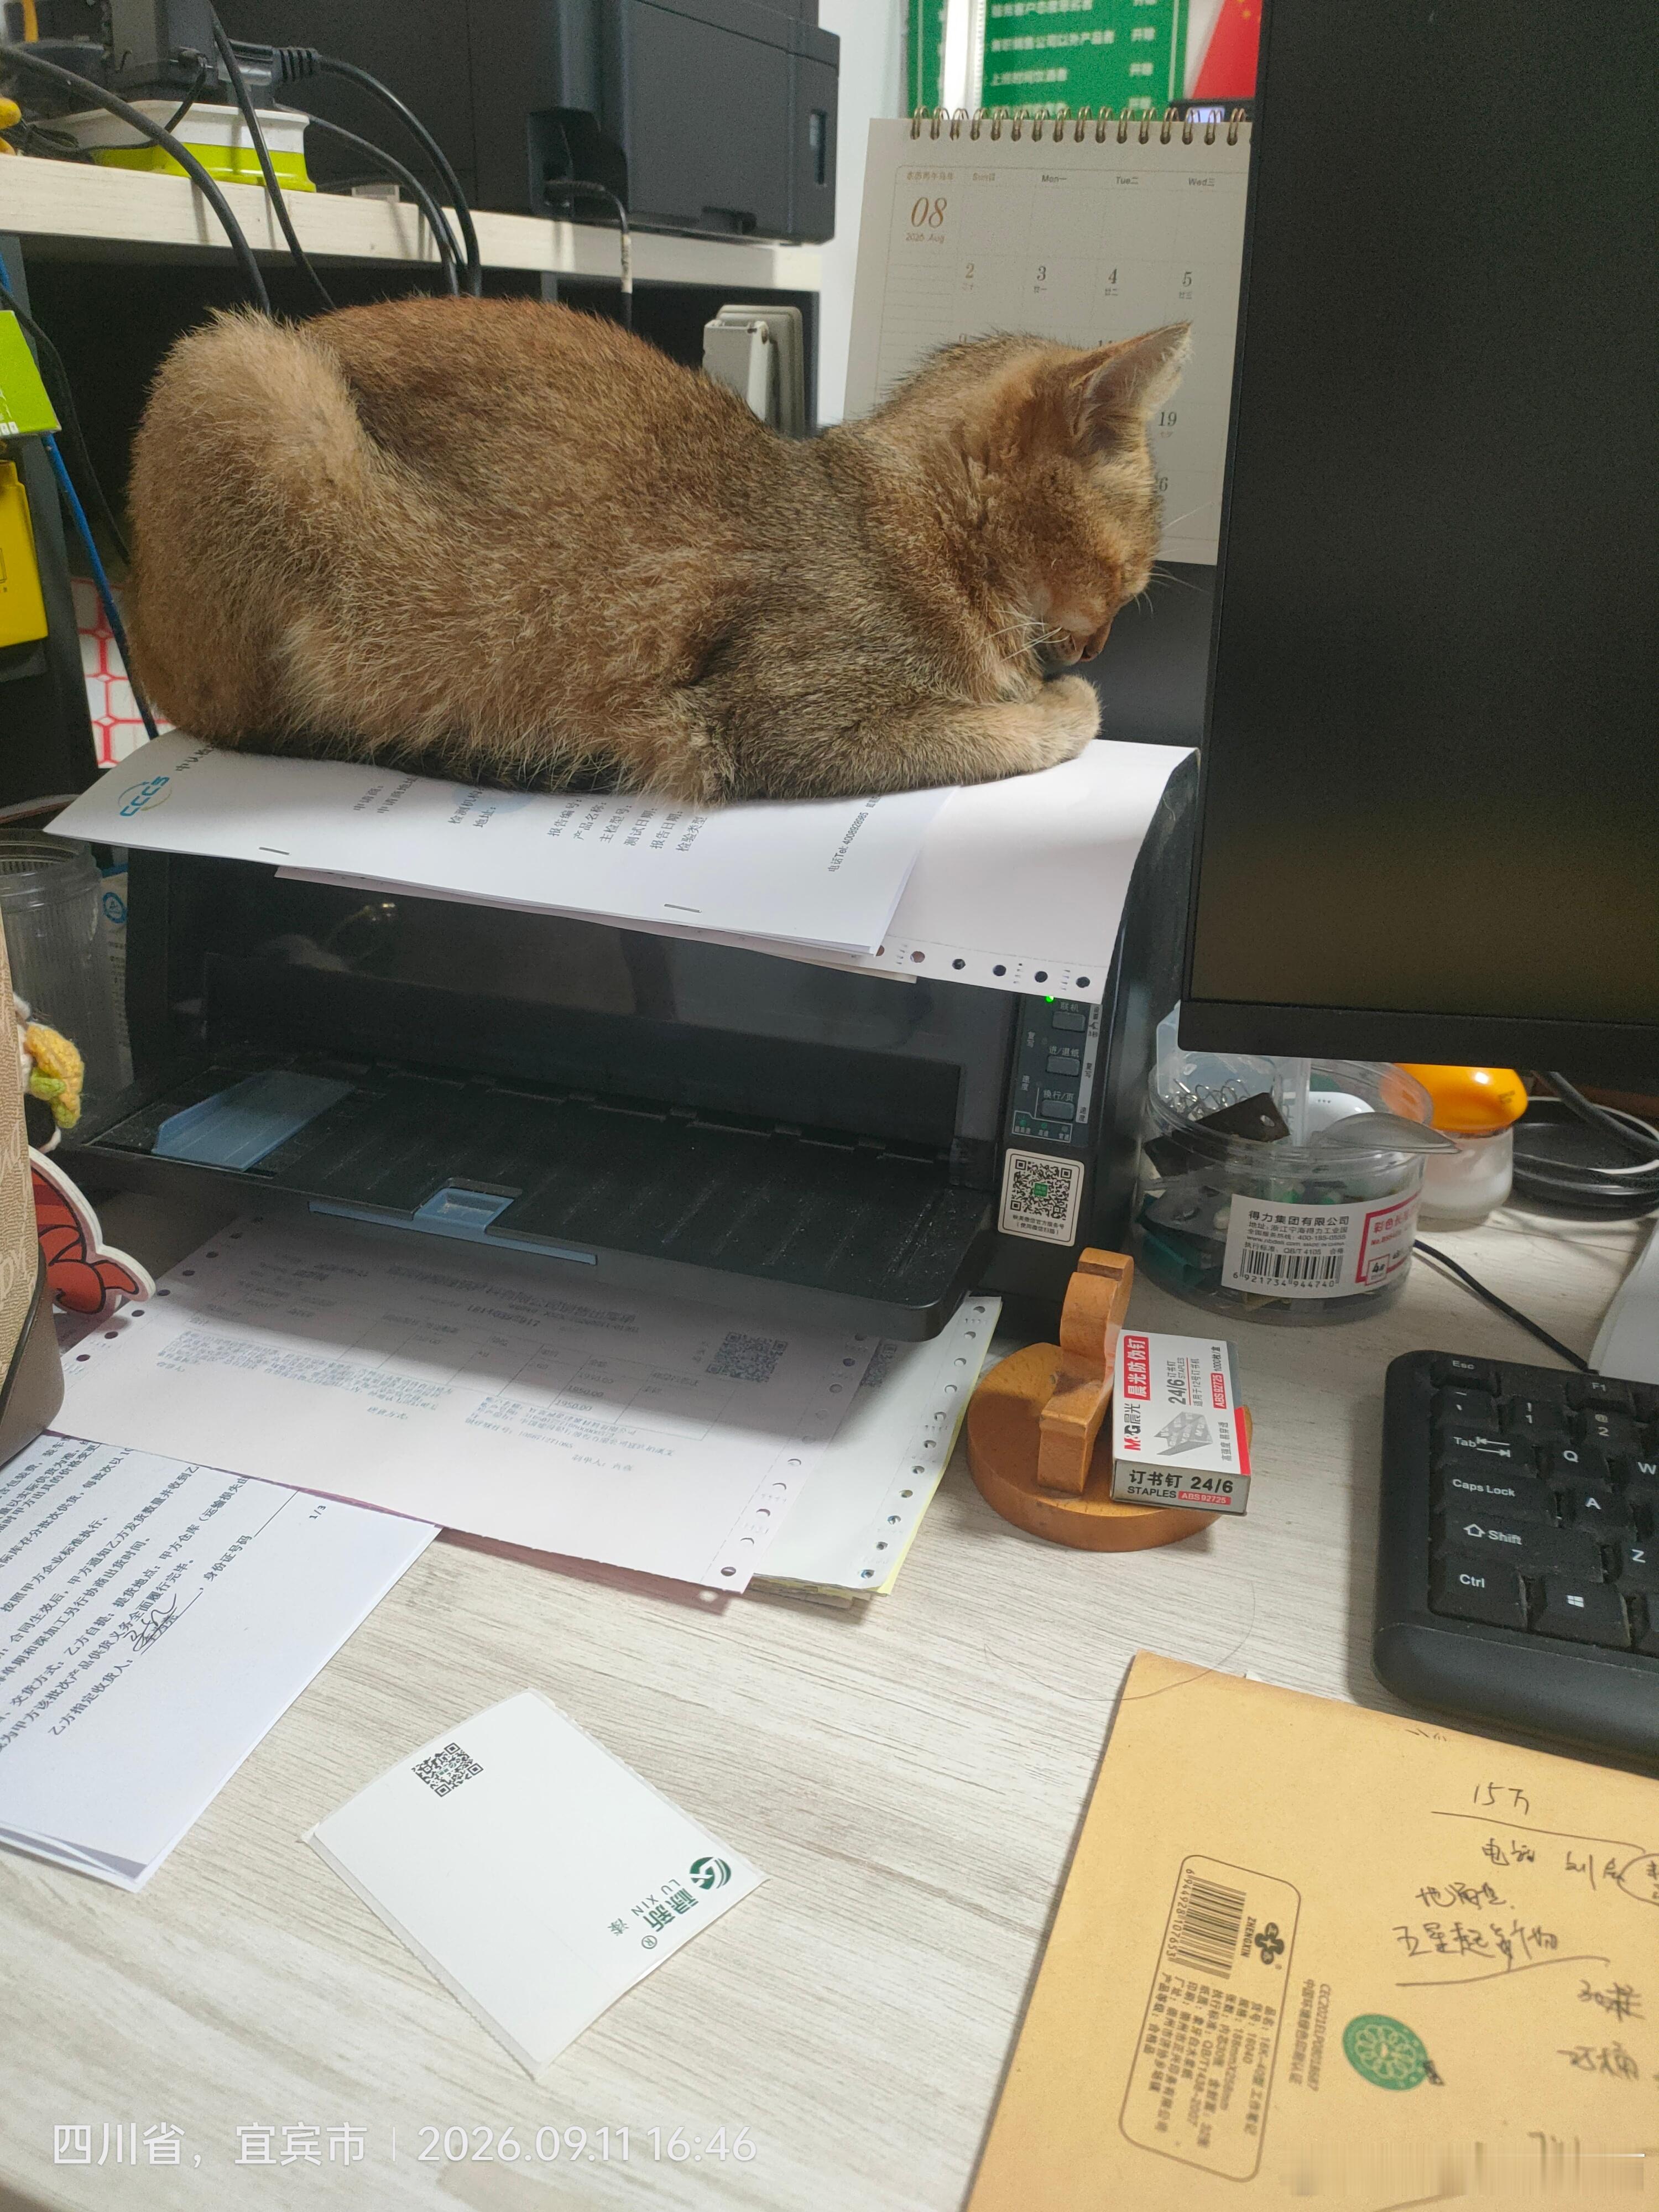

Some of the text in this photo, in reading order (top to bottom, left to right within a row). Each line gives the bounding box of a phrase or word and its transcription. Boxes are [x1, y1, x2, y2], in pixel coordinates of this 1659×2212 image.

[911, 197, 947, 228] 08
[966, 263, 975, 278] 2
[1036, 266, 1046, 281] 3
[1108, 269, 1118, 284] 4
[1182, 272, 1192, 287] 5
[1158, 411, 1177, 426] 19
[119, 776, 170, 817] CCCS
[547, 798, 581, 837] 报告编号：
[573, 801, 607, 841] 产品名称：
[599, 805, 632, 844] 主检型号：
[624, 807, 658, 847] 测试日期：
[650, 811, 683, 850] 报告日期：
[675, 815, 708, 853] 检验类型
[1249, 1210, 1349, 1226] 得力集团有限公司
[1244, 1274, 1287, 1286] 921734
[1126, 1338, 1147, 1398] 晨光防伪钉
[1167, 1360, 1176, 1379] 订书钉
[1177, 1357, 1186, 1379] STAPLES
[1452, 1360, 1475, 1370] Esc
[1168, 1377, 1187, 1406] 24/6
[1190, 1358, 1203, 1407] 适用于12号订书机
[1212, 1374, 1224, 1407] ABS 92725
[1592, 1382, 1606, 1392] F1
[1525, 1415, 1533, 1424] 1
[1598, 1426, 1609, 1437] 2
[1453, 1436, 1477, 1448] Tab
[1563, 1450, 1579, 1463] Q
[1637, 1462, 1657, 1475] W
[1129, 1469, 1234, 1494] 订书钉 24/6
[1452, 1478, 1515, 1497] Caps Lock
[1127, 1486, 1227, 1505] STAPLES ABS 92725
[1585, 1497, 1601, 1510] A
[309, 1505, 327, 1520] 1/3
[1488, 1530, 1522, 1545] Shift
[1631, 1549, 1646, 1563] Z
[1459, 1573, 1485, 1588] Ctrl
[48, 1660, 133, 1735] 乙方指定收货人：
[1175, 1878, 1193, 1916] 944928
[1166, 1918, 1182, 1958] 107653
[1240, 1916, 1257, 1958] ZHENGXIN
